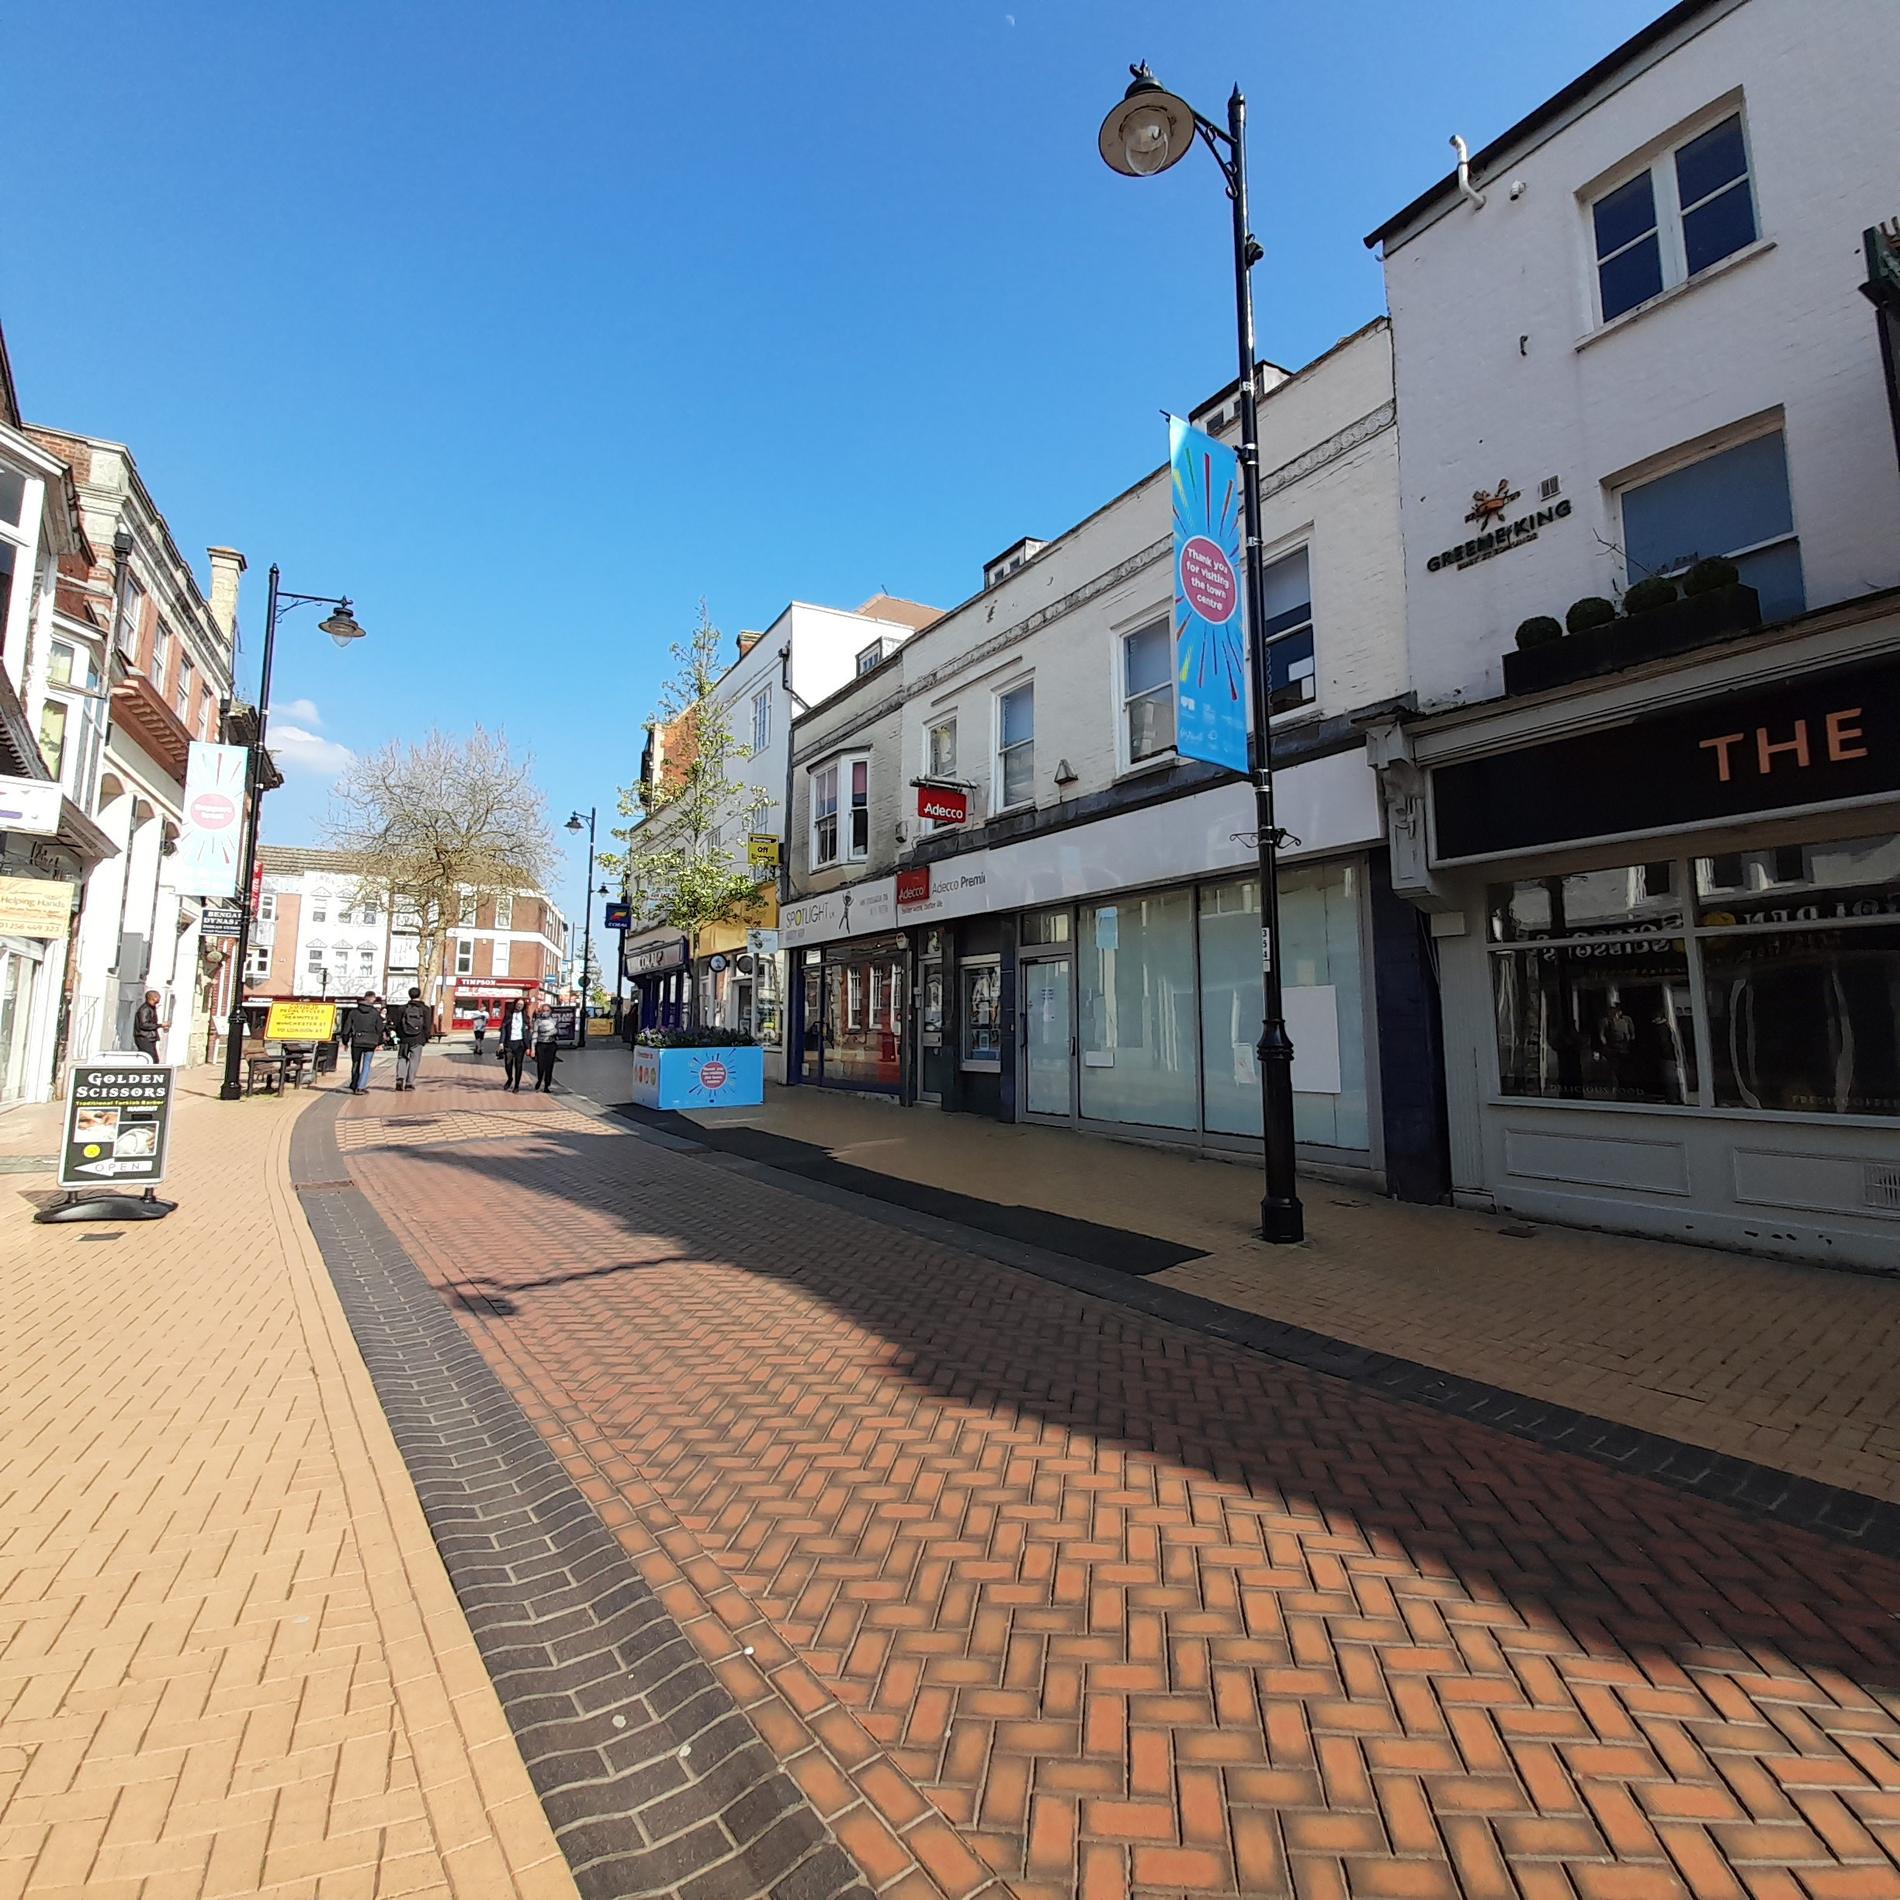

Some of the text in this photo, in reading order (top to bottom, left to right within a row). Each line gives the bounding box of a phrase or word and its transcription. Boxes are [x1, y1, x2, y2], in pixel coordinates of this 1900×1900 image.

[1427, 499, 1572, 572] GREENE KING
[1187, 547, 1229, 574] Thank you
[1186, 560, 1230, 589] for visiting
[1191, 577, 1227, 599] the town
[1197, 594, 1223, 611] centre
[1700, 707, 1868, 781] THE
[923, 802, 964, 819] Adecco
[899, 886, 925, 901] Adecco
[932, 880, 960, 895] Adecco
[1, 896, 65, 908] Helping Hands
[786, 902, 829, 929] SPOTLIGHT
[88, 1072, 165, 1086] GOLDEN
[76, 1086, 166, 1098] SCISSORS
[95, 1163, 140, 1172] OPEN
